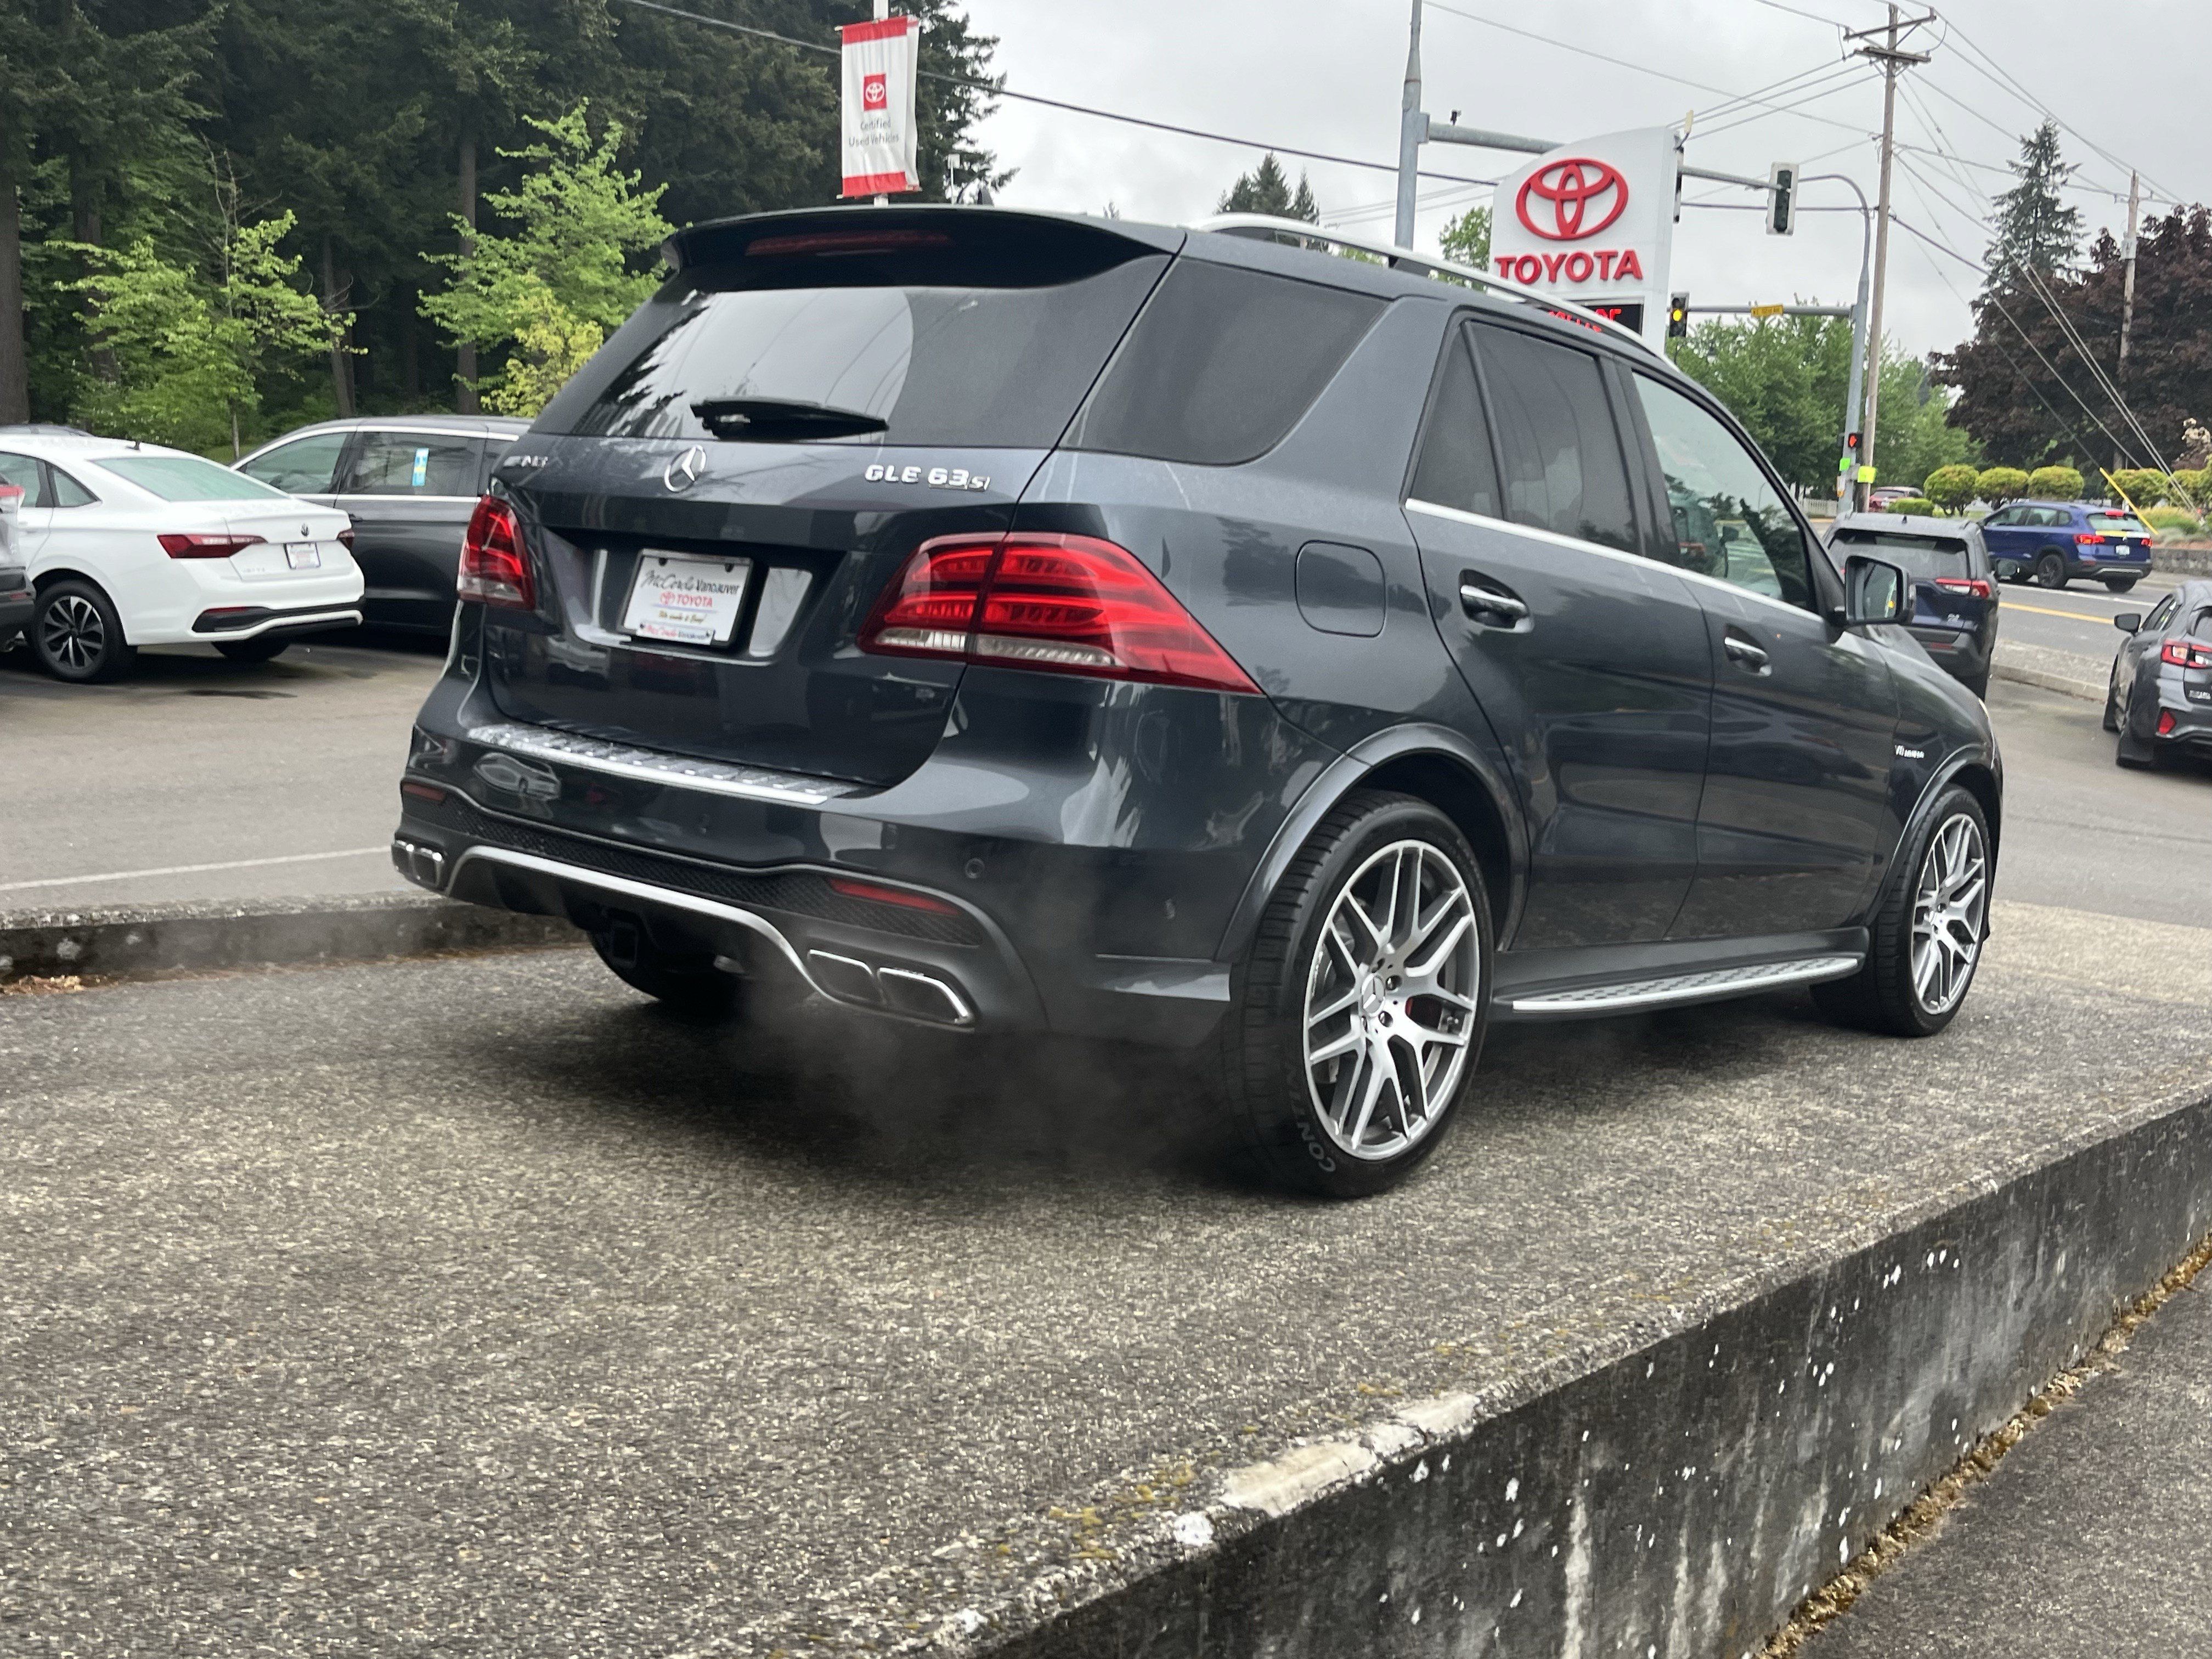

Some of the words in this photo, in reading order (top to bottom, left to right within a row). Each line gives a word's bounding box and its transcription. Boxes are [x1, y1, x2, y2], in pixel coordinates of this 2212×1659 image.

[849, 135, 870, 148] Used
[1494, 249, 1644, 285] TOYOTA
[864, 464, 922, 484] GLE
[676, 593, 713, 608] TOYOTA
